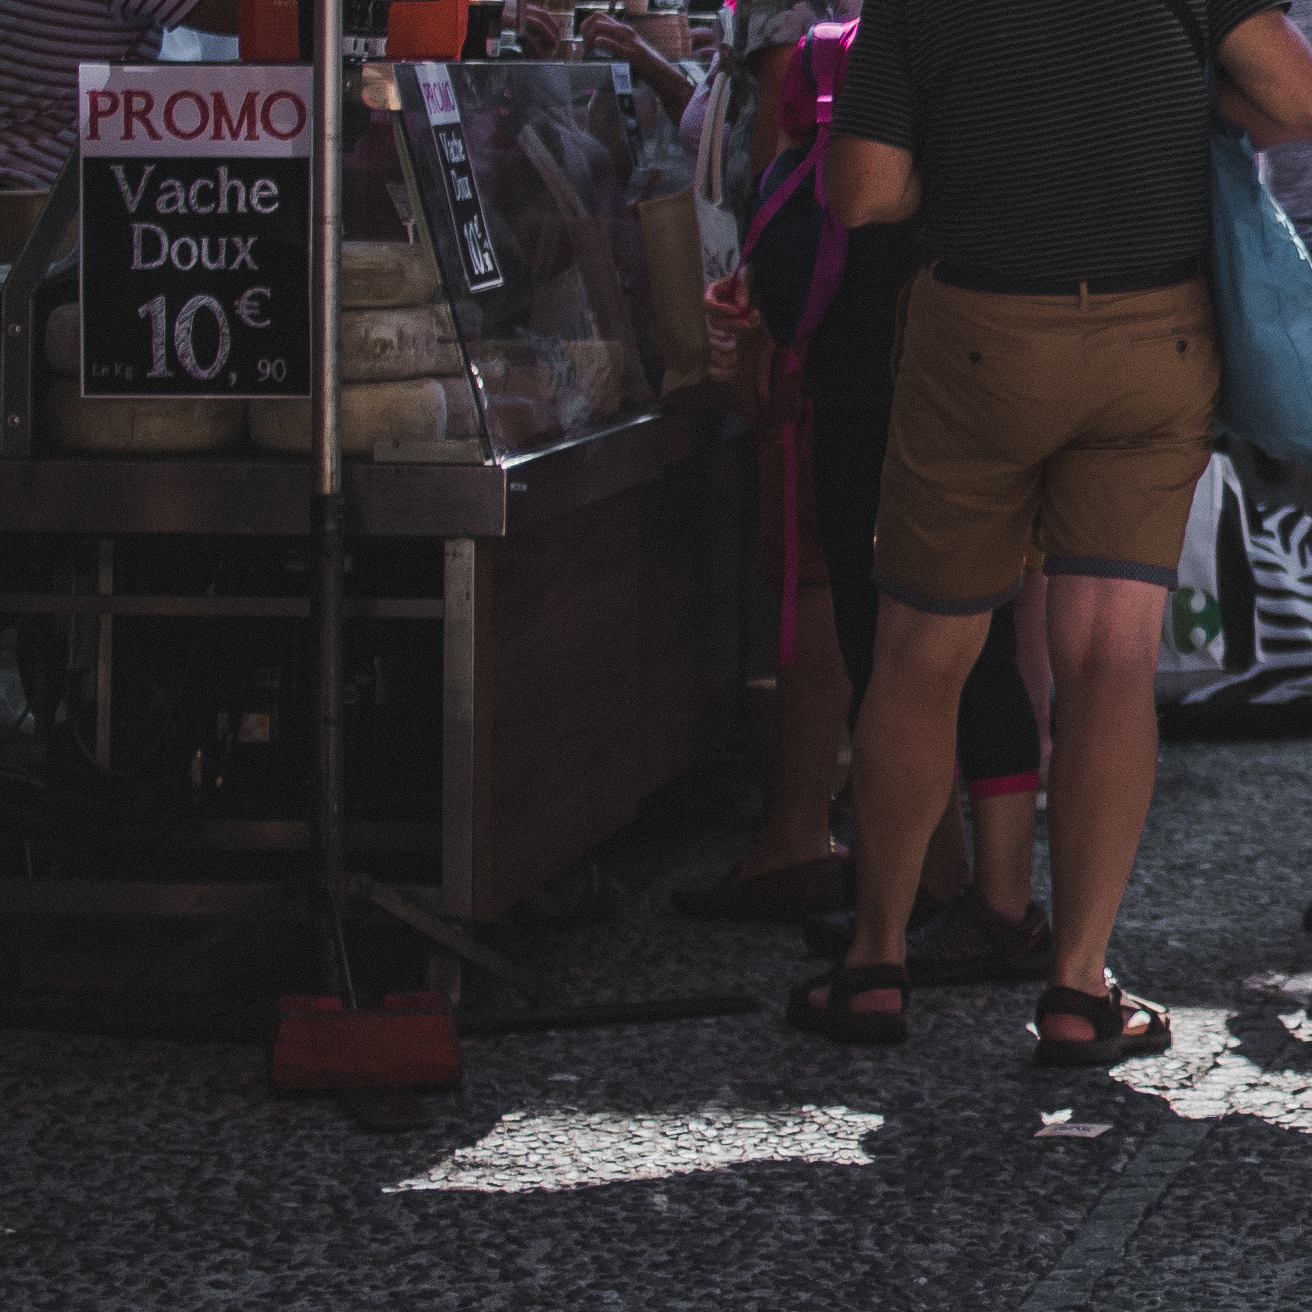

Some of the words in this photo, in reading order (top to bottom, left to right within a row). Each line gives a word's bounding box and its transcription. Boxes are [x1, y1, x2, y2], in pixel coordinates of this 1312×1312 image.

[86, 89, 307, 141] PROMO
[110, 164, 281, 215] Vache
[129, 222, 259, 271] Doux
[256, 358, 287, 384] 90
